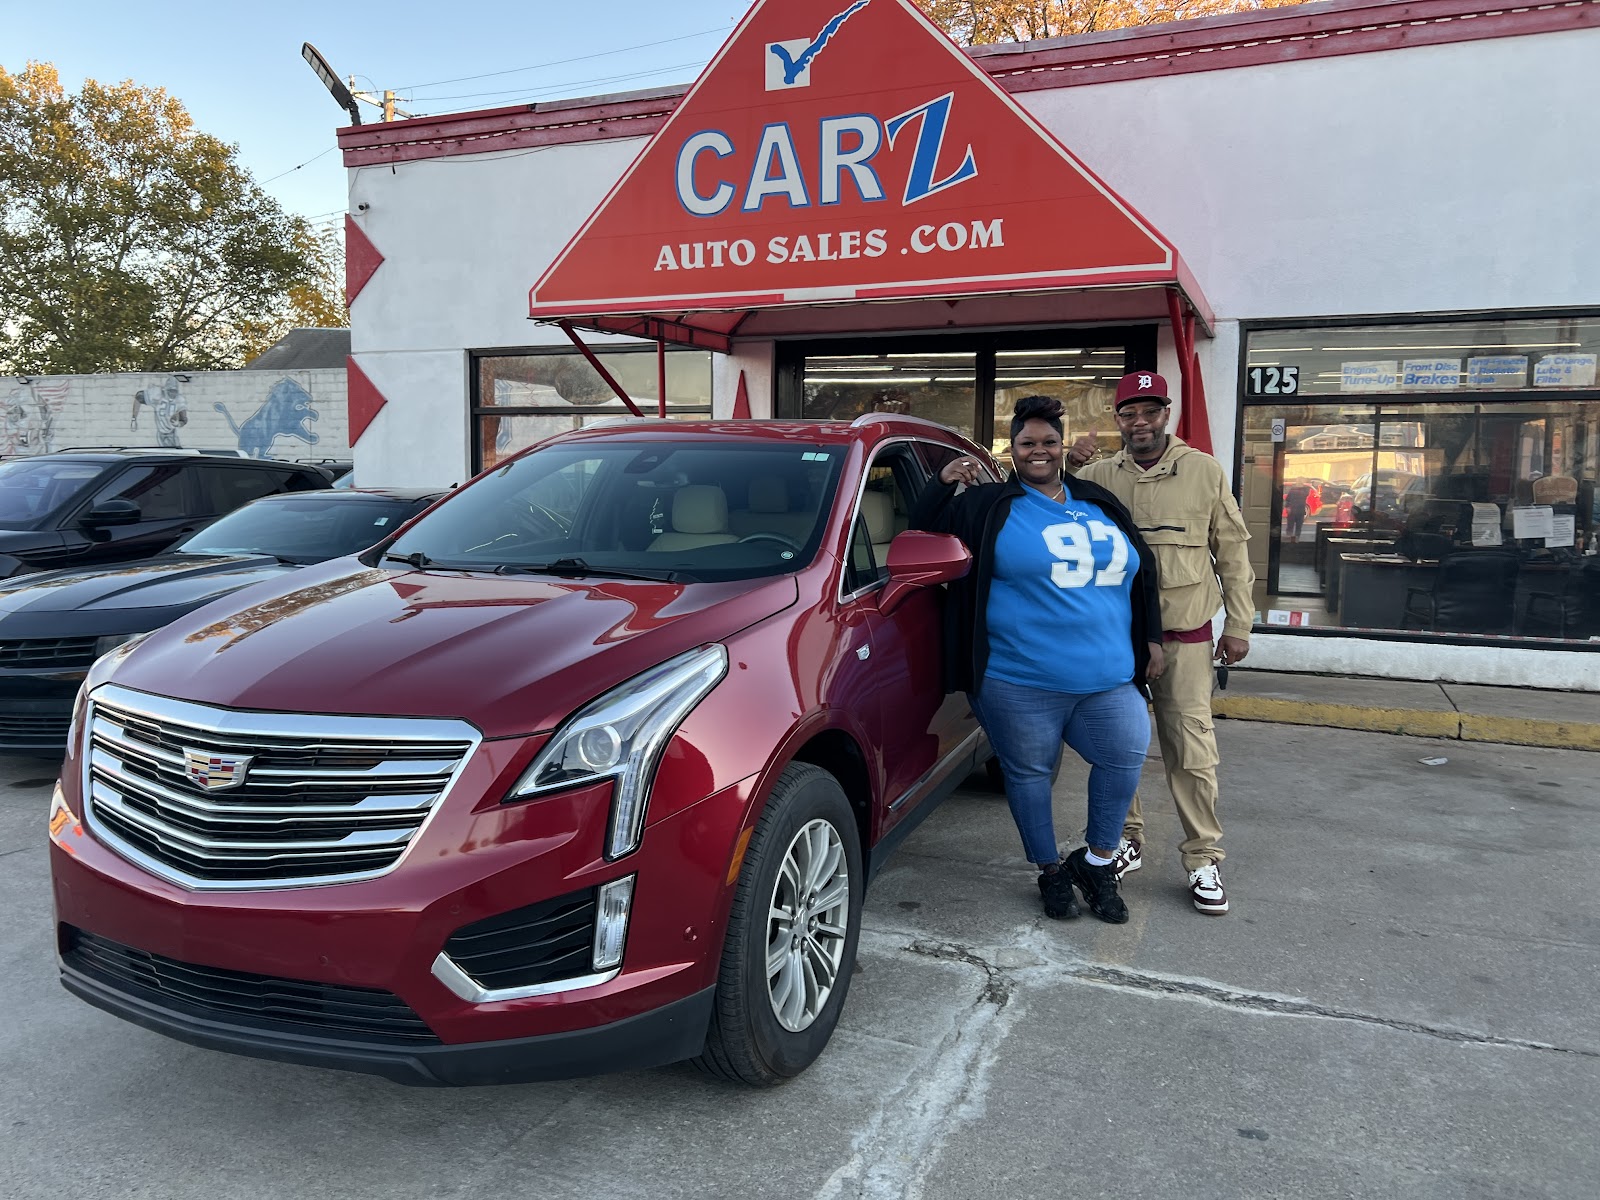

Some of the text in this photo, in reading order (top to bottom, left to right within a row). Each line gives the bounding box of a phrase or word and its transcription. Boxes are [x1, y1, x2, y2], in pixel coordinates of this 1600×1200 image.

[675, 92, 978, 217] CARZ
[654, 218, 1005, 271] AUTO SALES .COM
[1343, 366, 1378, 376] Engine
[1404, 362, 1458, 371] Front Disc
[1536, 366, 1561, 375] Lube
[1138, 375, 1152, 390] D
[1250, 367, 1298, 394] 125
[1343, 374, 1396, 385] Tune-Up
[1403, 373, 1458, 385] Brakes
[1535, 375, 1563, 384] Filter
[1042, 520, 1128, 588] 97
